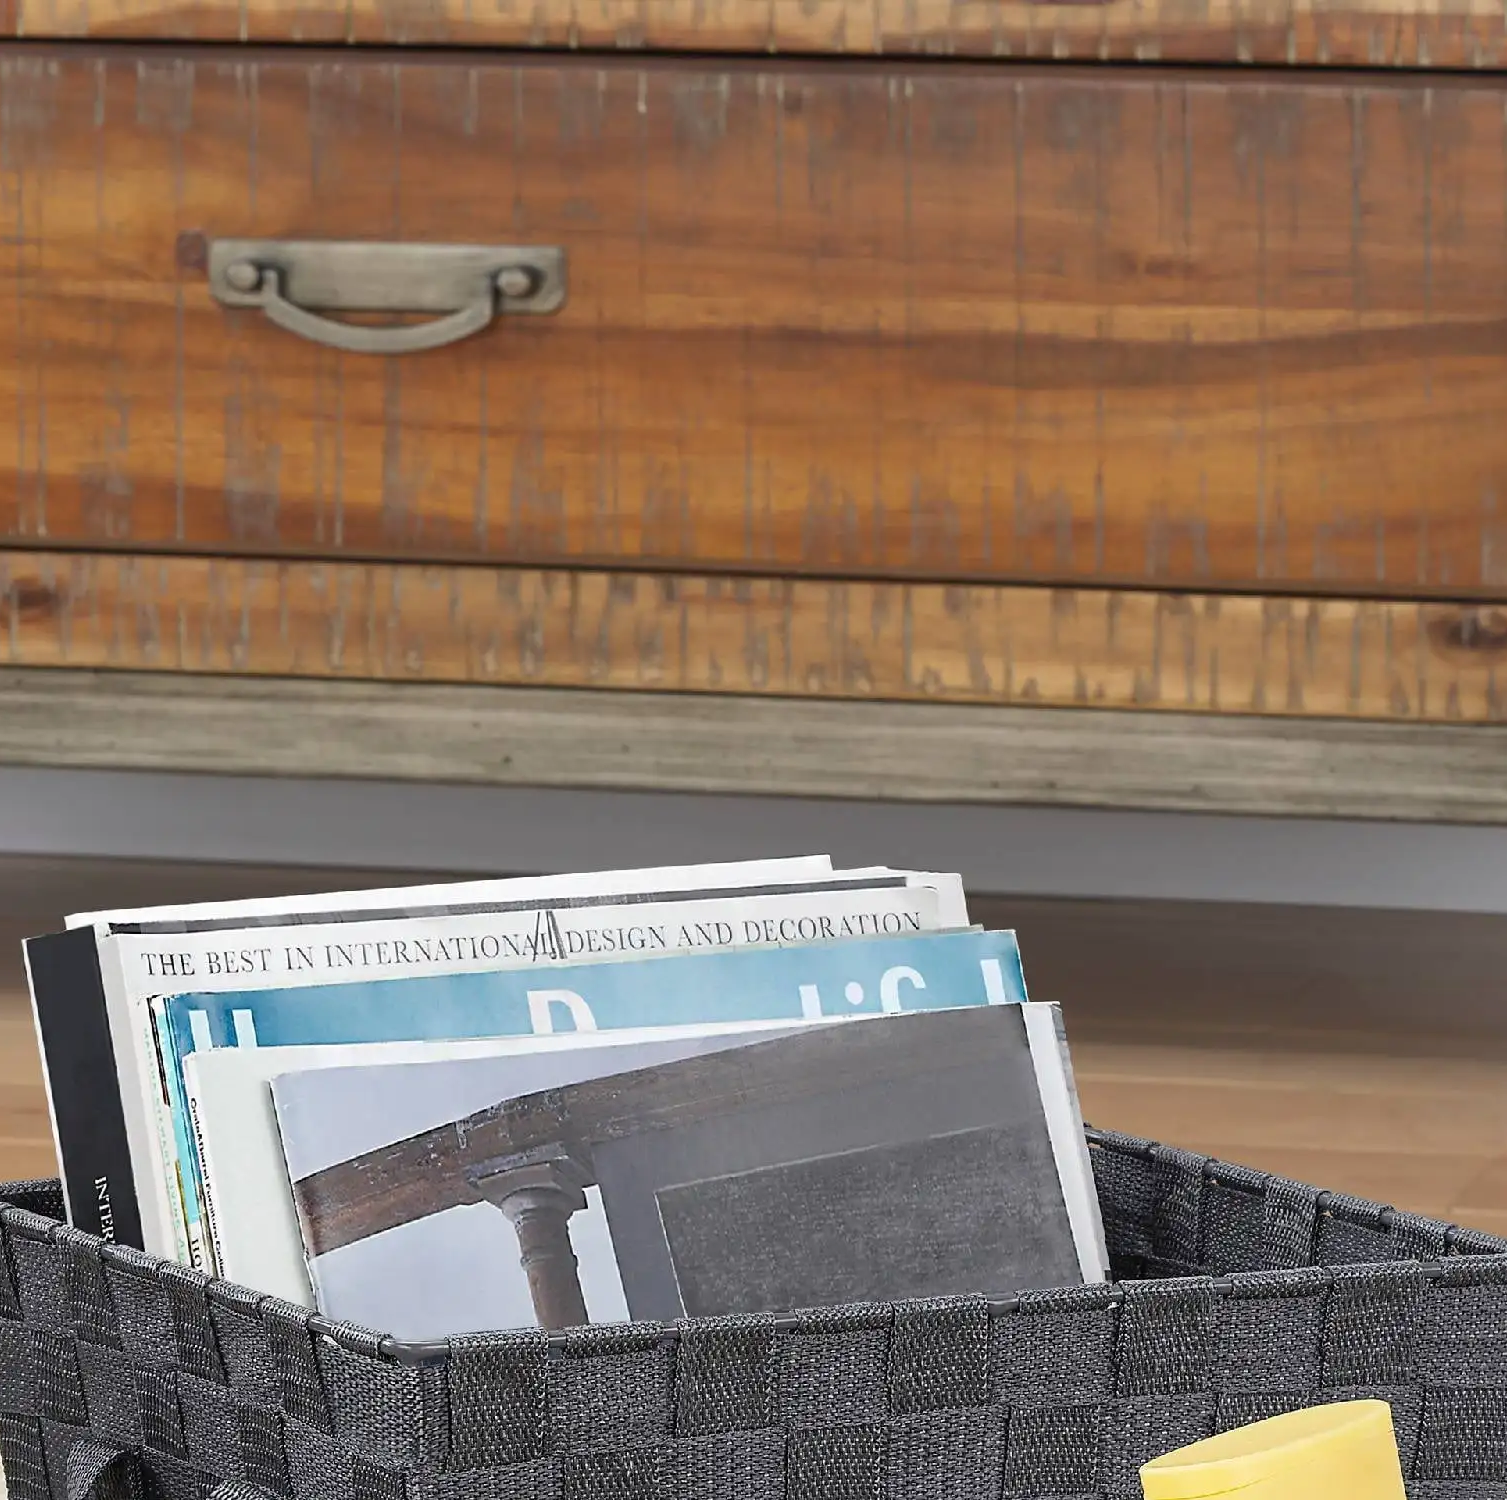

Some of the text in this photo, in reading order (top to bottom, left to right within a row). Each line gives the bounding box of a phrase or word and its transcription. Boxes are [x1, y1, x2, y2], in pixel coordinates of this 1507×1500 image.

[140, 911, 922, 977] THE BEST IN INTERNATIONAL DESIGN AND DECORATION
[94, 1175, 117, 1247] INTER
